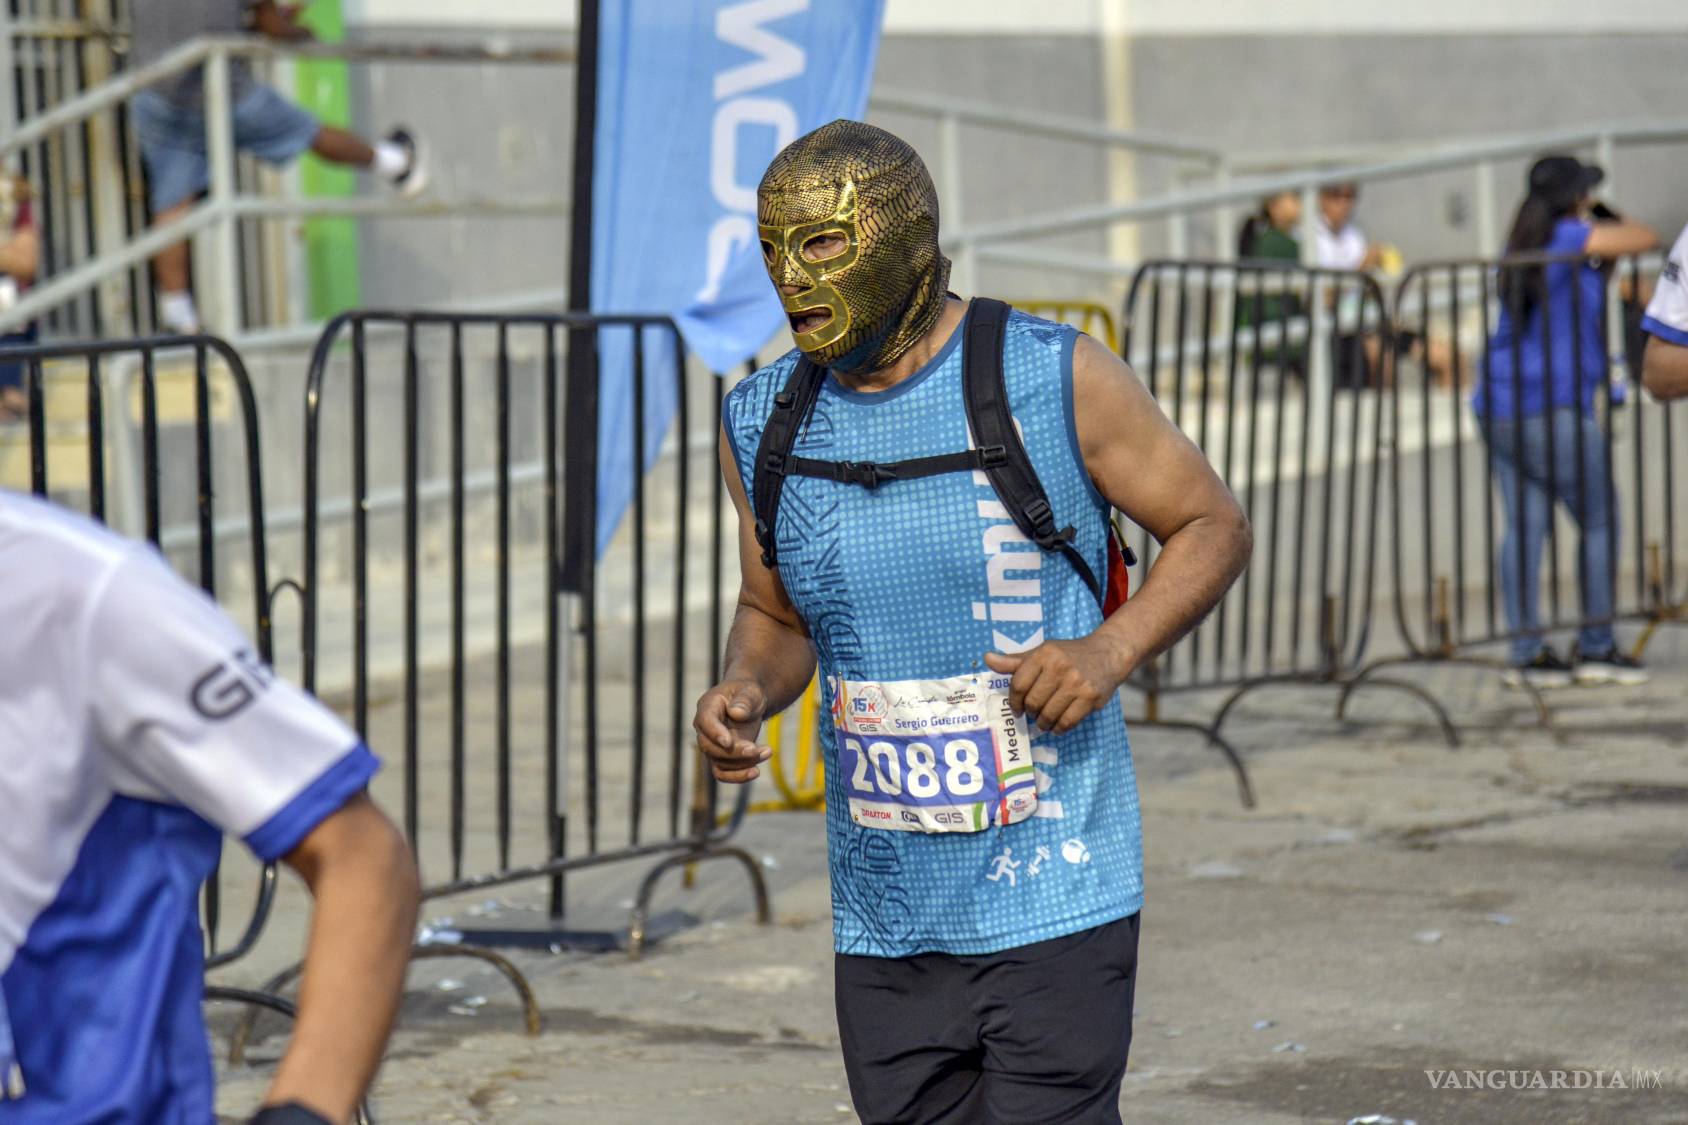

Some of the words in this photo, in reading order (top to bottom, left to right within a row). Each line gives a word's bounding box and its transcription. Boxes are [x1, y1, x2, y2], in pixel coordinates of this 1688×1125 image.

[859, 723, 878, 732] GIS
[895, 717, 928, 731] Sergio
[930, 714, 979, 727] Guerrero
[1001, 698, 1020, 762] Medalla
[846, 739, 984, 798] 2088
[934, 811, 964, 824] GIS
